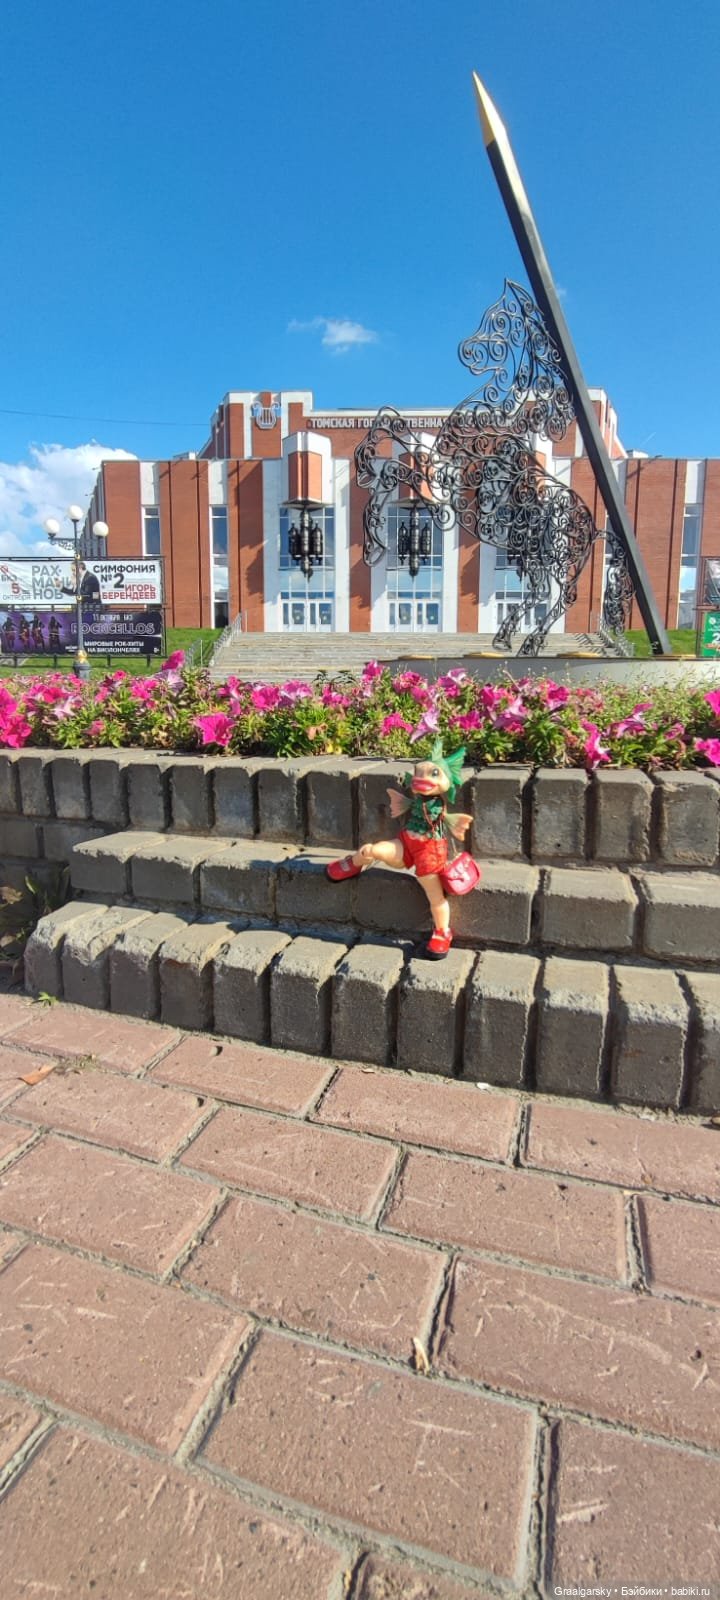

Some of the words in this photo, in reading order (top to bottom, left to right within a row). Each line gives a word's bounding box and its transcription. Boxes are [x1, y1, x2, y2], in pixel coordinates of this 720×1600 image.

[310, 417, 355, 428] ТОМСКАЯ
[93, 564, 156, 573] СИМФОНИЯ
[113, 573, 125, 588] 2
[11, 582, 20, 594] 5
[125, 584, 156, 592] ИГОРЬ
[102, 591, 156, 600] БЕРЕНДЕЕВ
